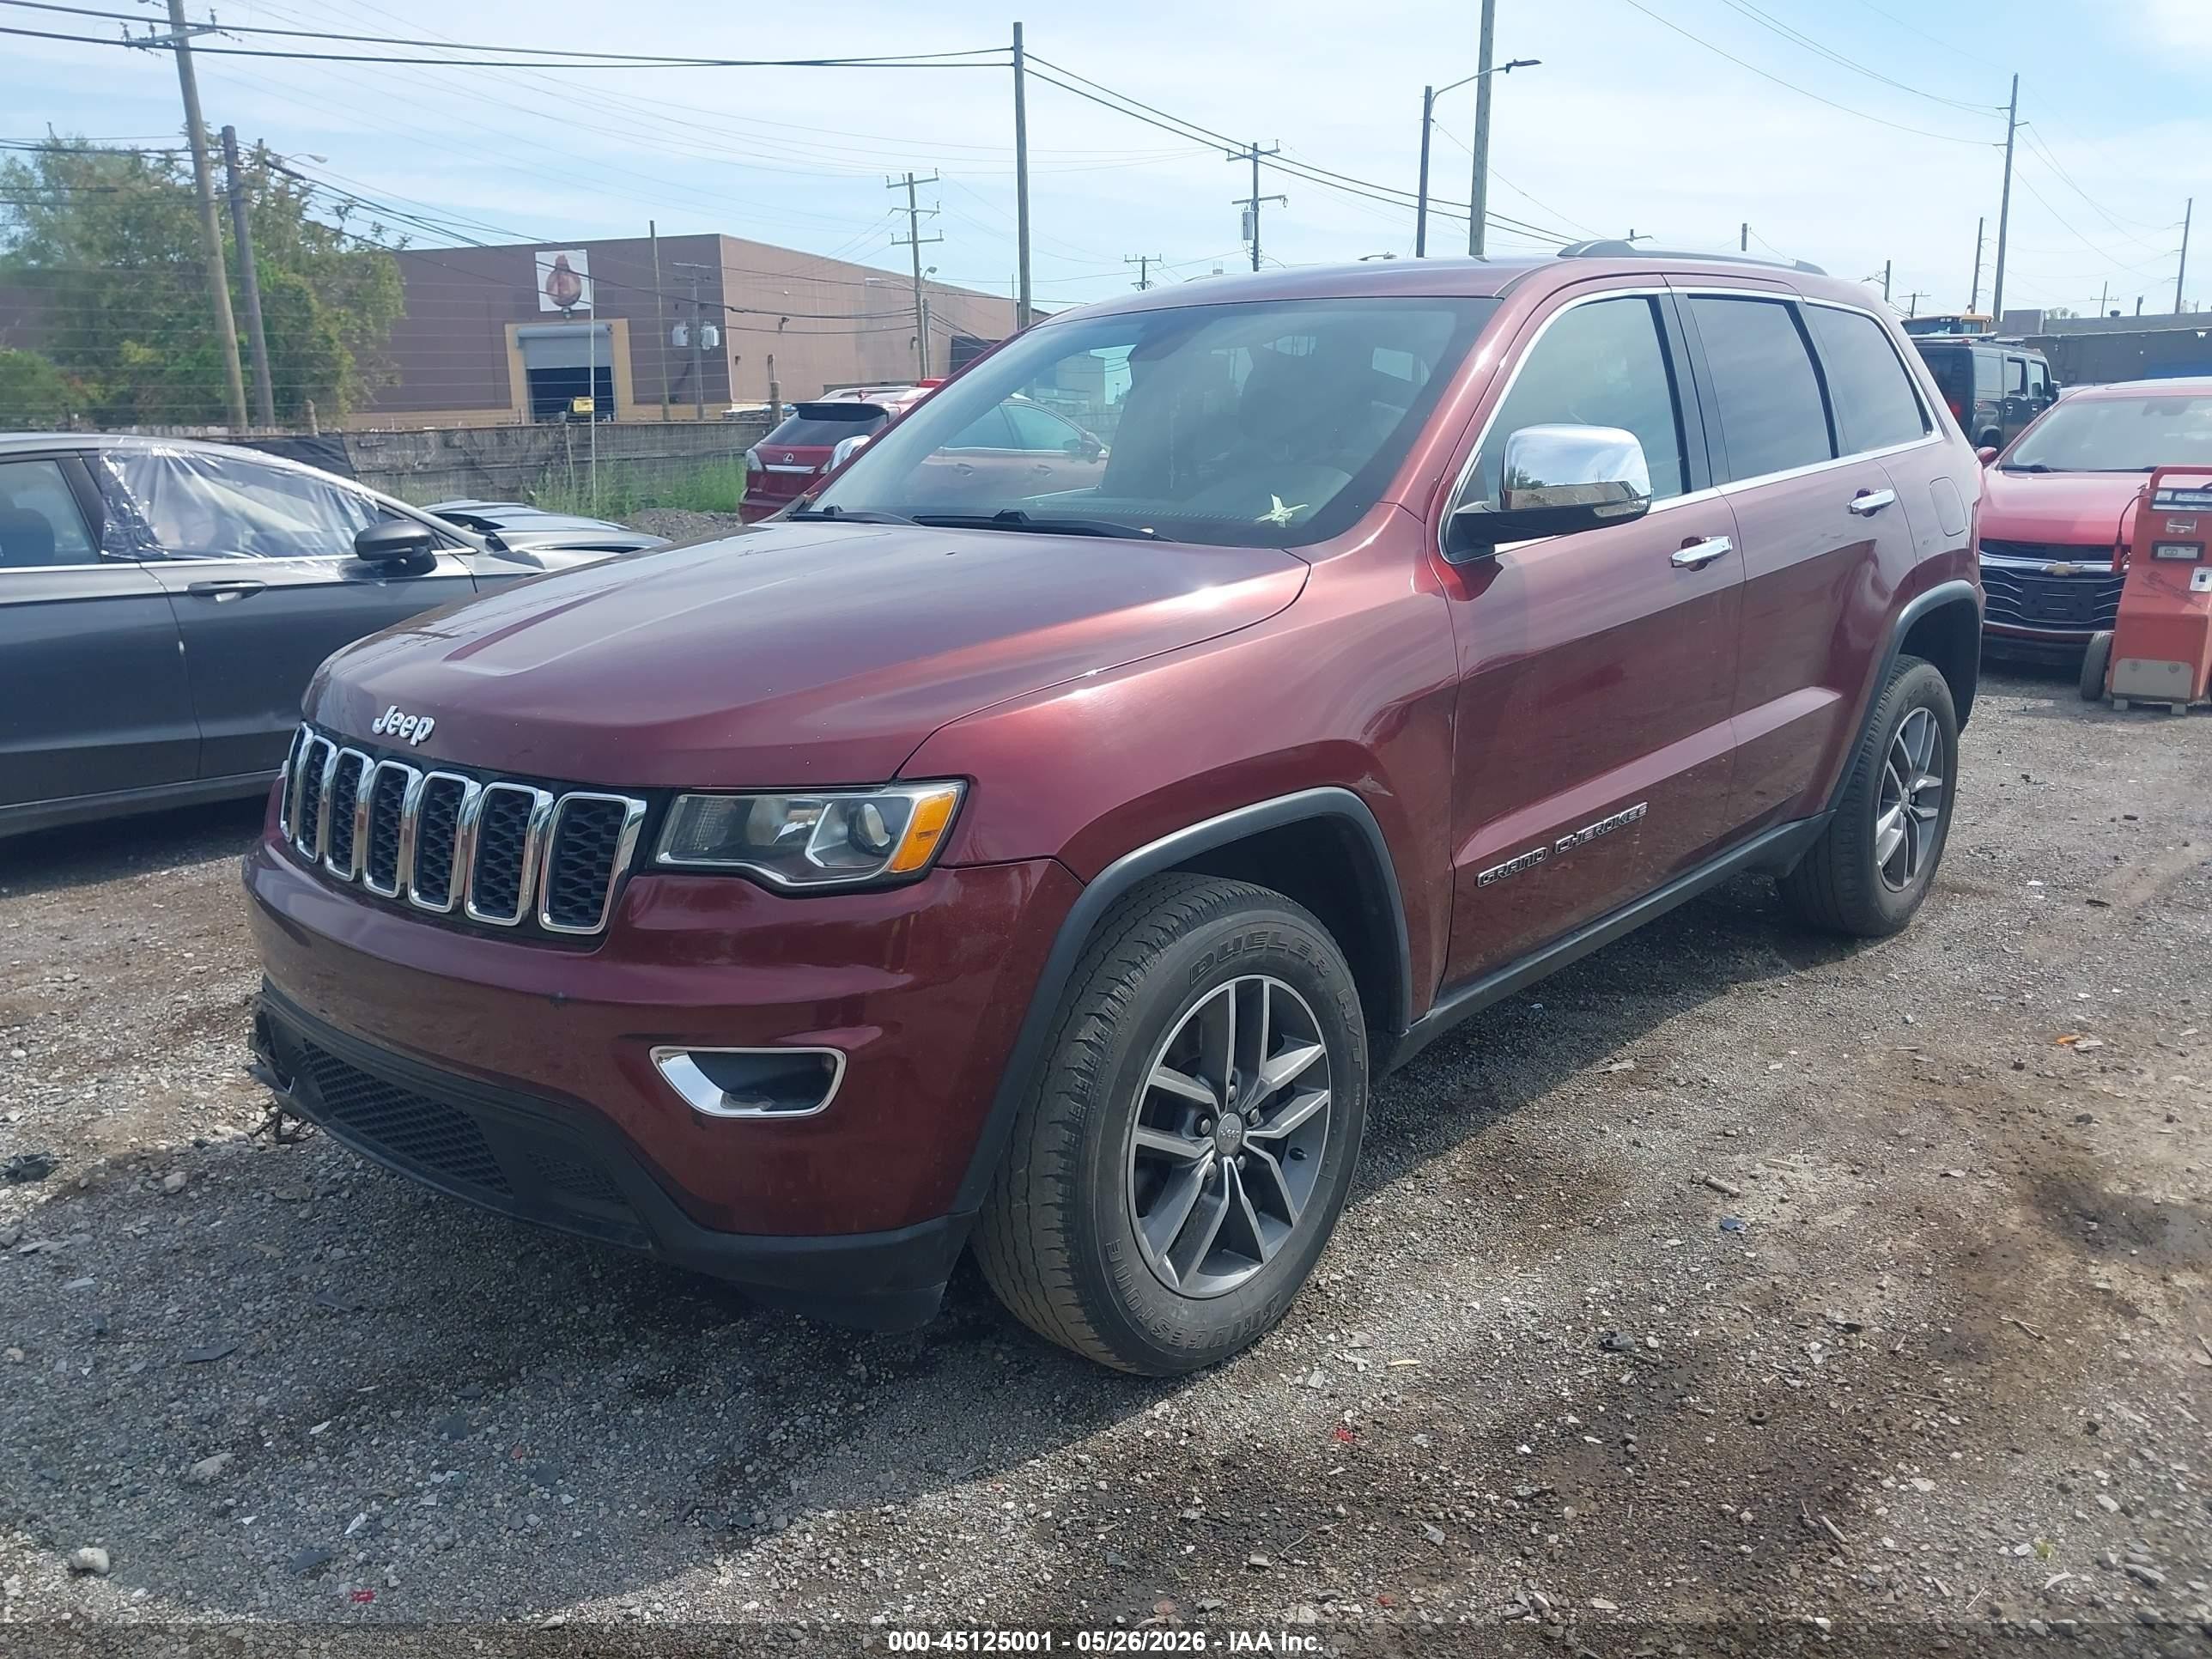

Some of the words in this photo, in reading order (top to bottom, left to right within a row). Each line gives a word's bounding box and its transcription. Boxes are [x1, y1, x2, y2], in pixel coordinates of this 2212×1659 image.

[371, 705, 435, 746] Jeep
[1476, 847, 1547, 888] GRAND
[1553, 800, 1649, 855] CHEROKEE
[1189, 930, 1330, 985] DUELER
